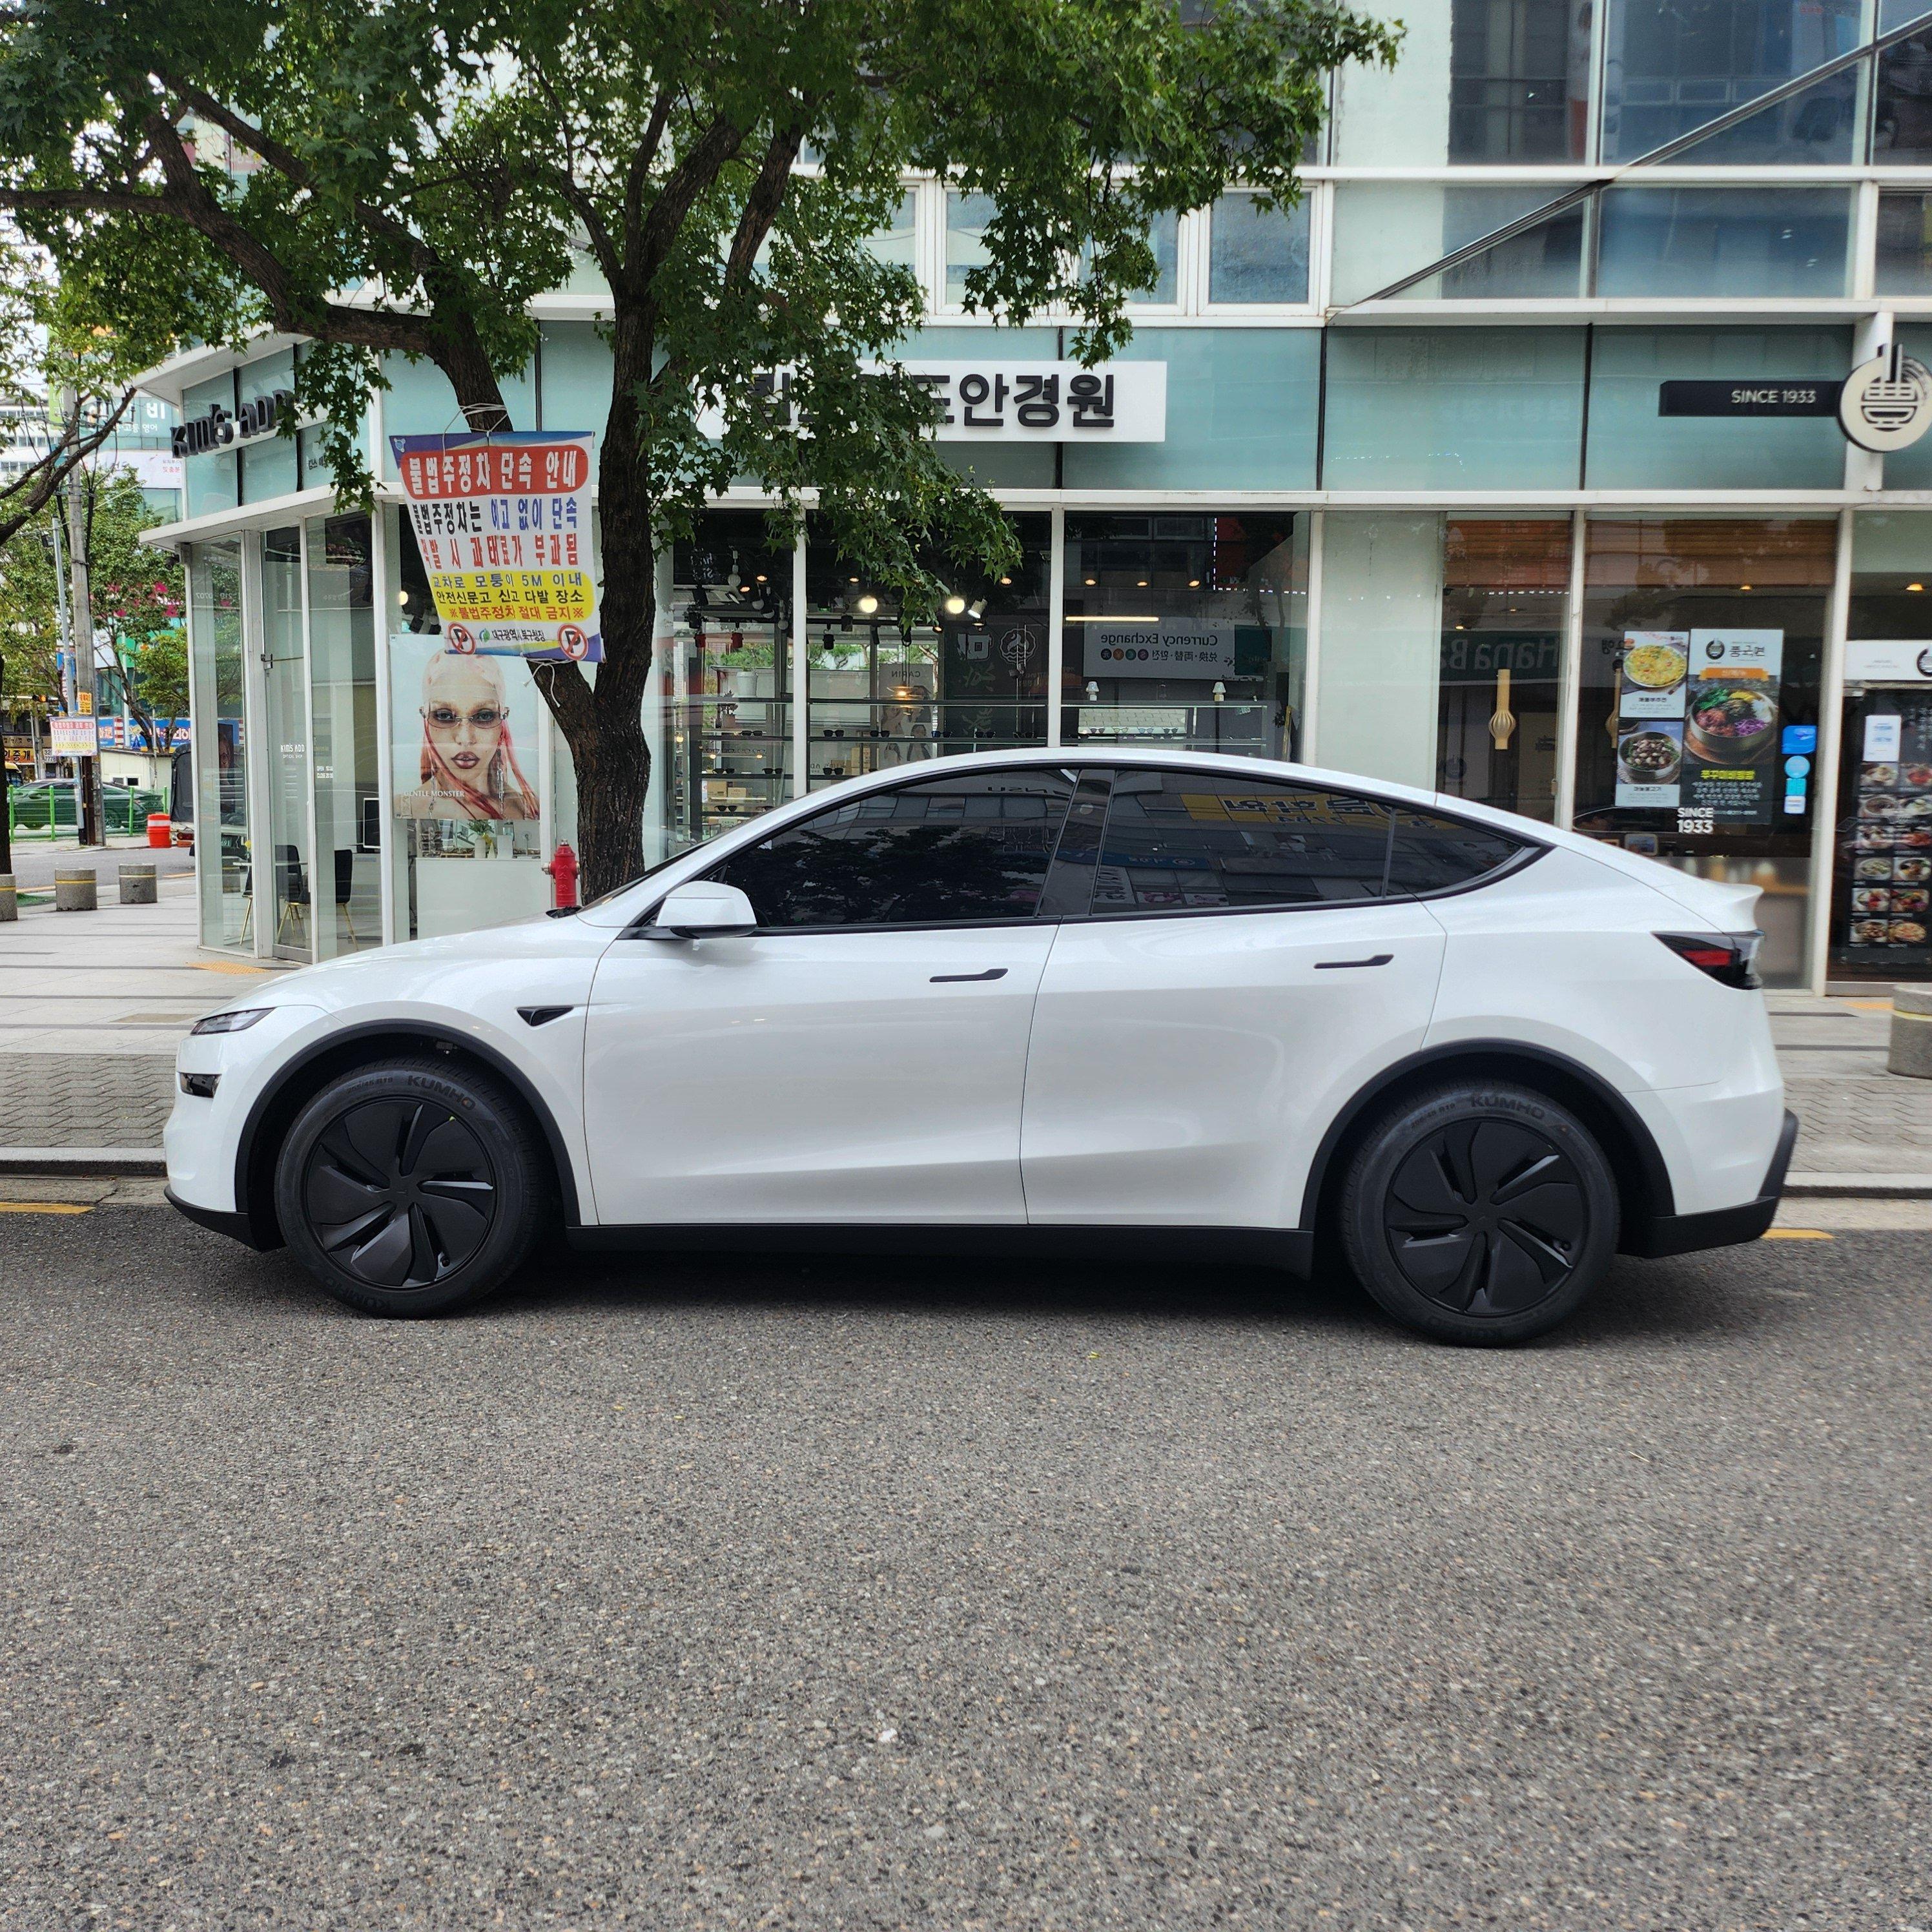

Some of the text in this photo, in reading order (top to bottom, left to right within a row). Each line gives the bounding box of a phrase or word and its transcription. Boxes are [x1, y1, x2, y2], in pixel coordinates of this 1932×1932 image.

[1731, 390, 1816, 404] SINCE 1933
[409, 450, 577, 495] 불법주정차 단속 안내
[412, 497, 577, 535] 불법주정차는 예고 없이 단속
[449, 539, 462, 569] 시
[470, 535, 524, 569] 과태료가
[535, 533, 578, 566] 부과됨
[433, 572, 582, 589] 교차로 모퉁이 5M 이내
[436, 589, 584, 604] 안전신문고 신고 다발 장소
[519, 606, 542, 621] 절대
[1677, 807, 1714, 819] SINCE
[1677, 819, 1713, 834] 1933
[406, 1074, 477, 1111] KUMHO
[1471, 1096, 1545, 1120] KUMHO
